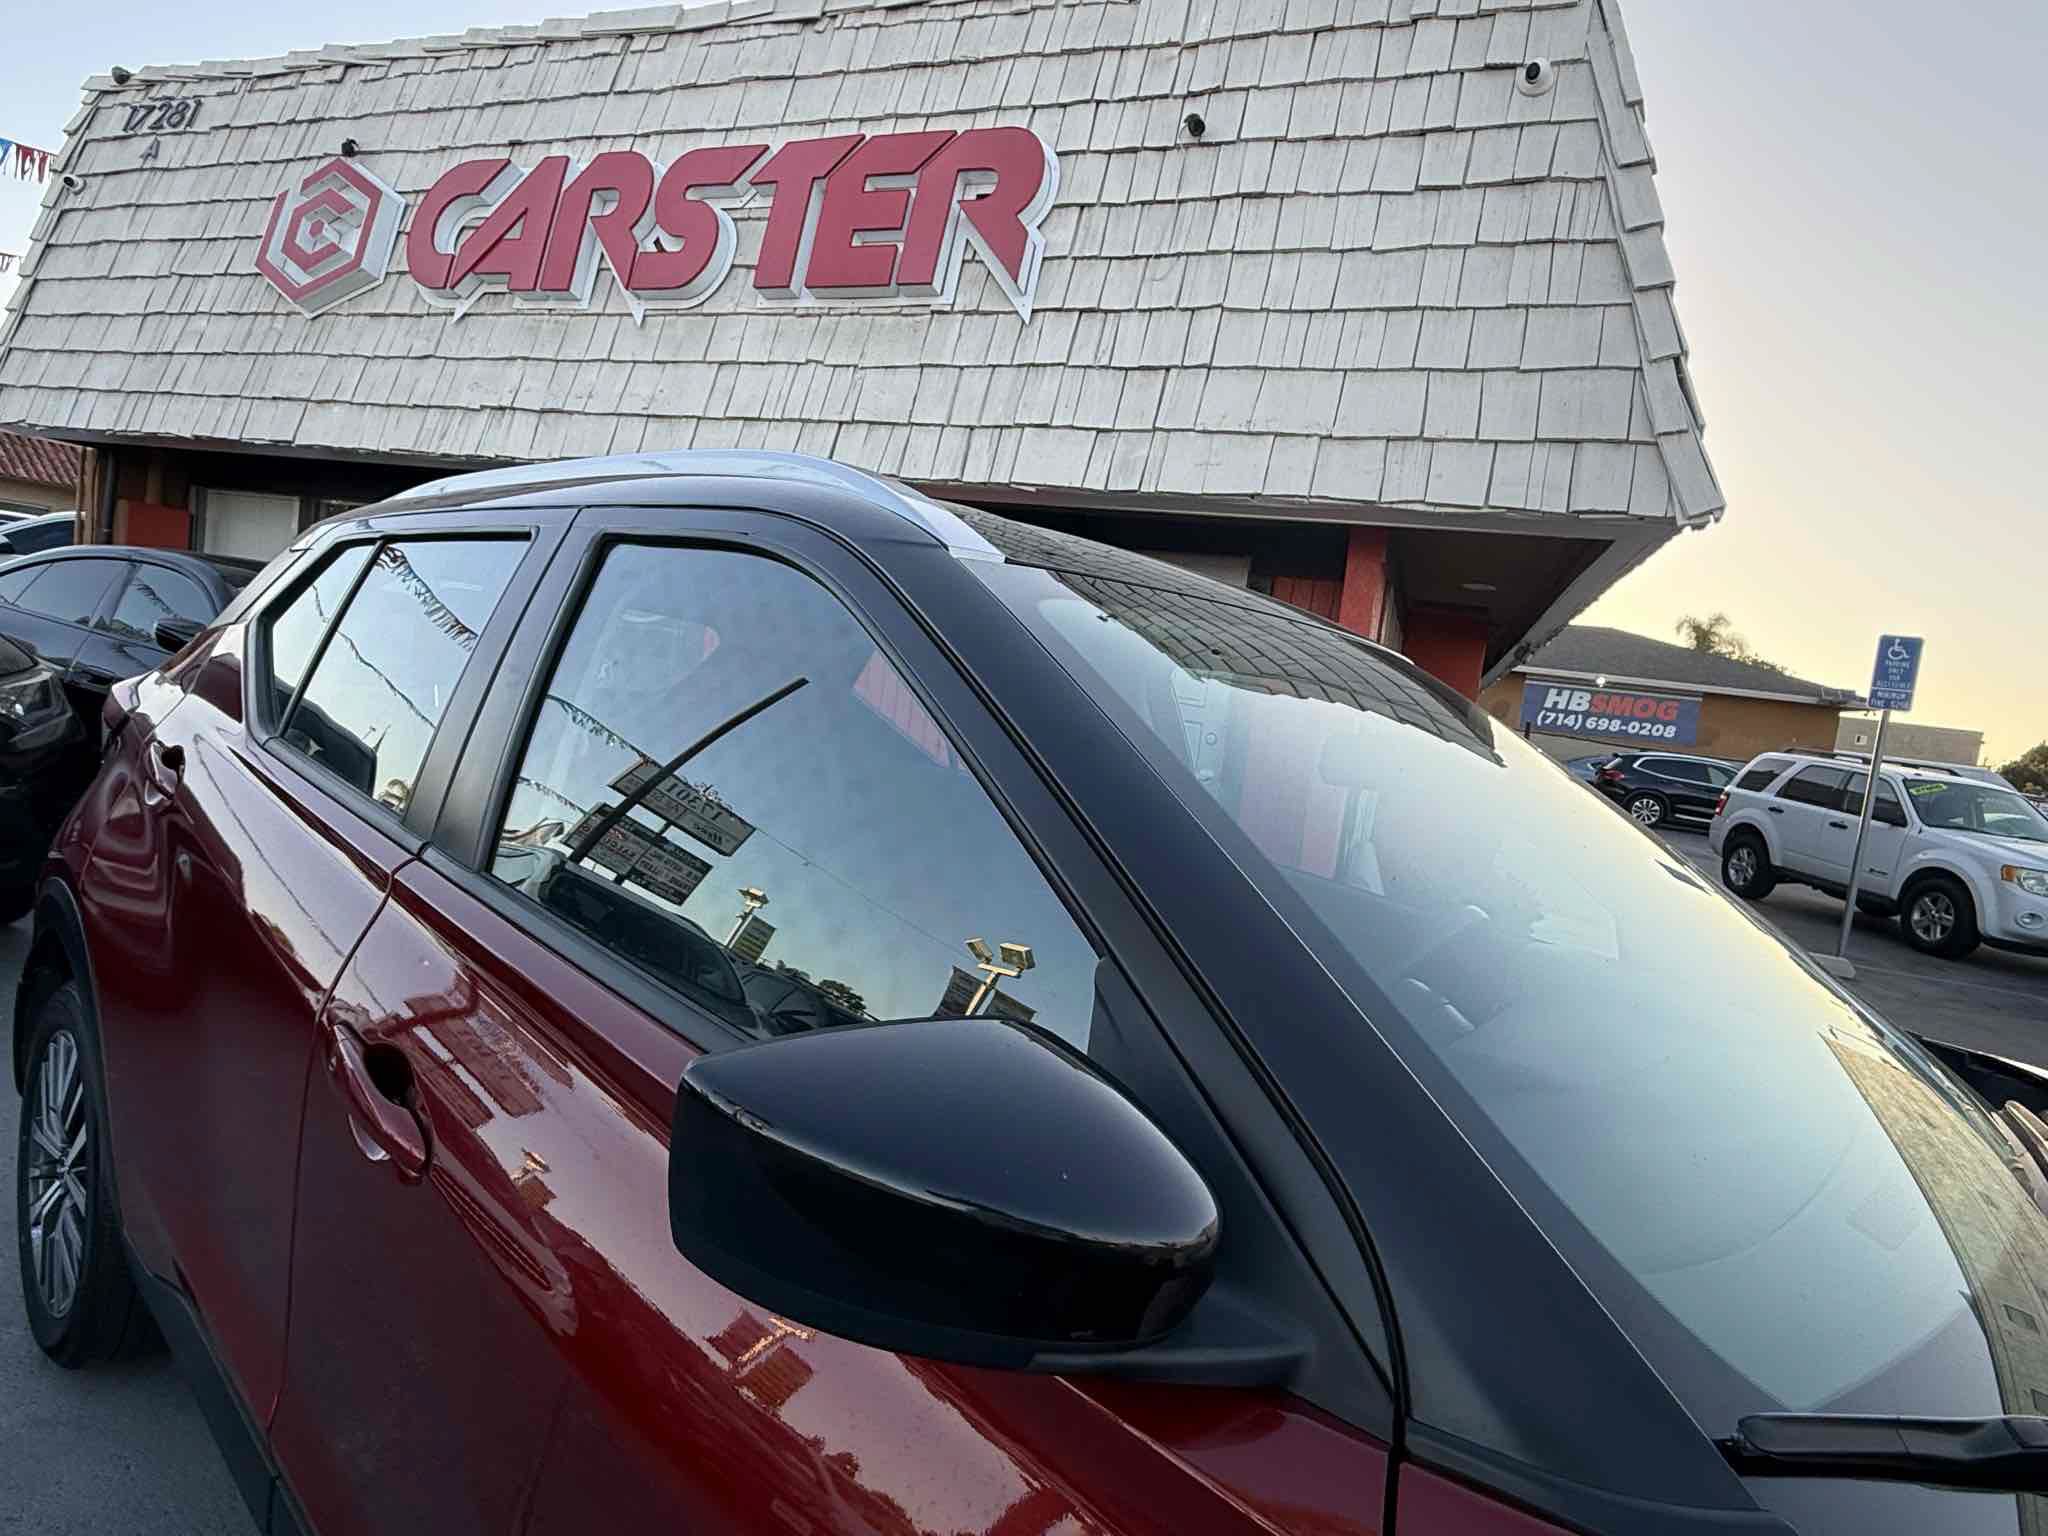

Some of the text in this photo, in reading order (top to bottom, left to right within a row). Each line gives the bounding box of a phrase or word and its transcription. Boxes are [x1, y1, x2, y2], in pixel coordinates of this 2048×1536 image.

[122, 98, 203, 133] 17281
[139, 136, 161, 168] A
[405, 126, 1050, 302] CARSTER
[1537, 710, 1677, 738] (714) 698-0208
